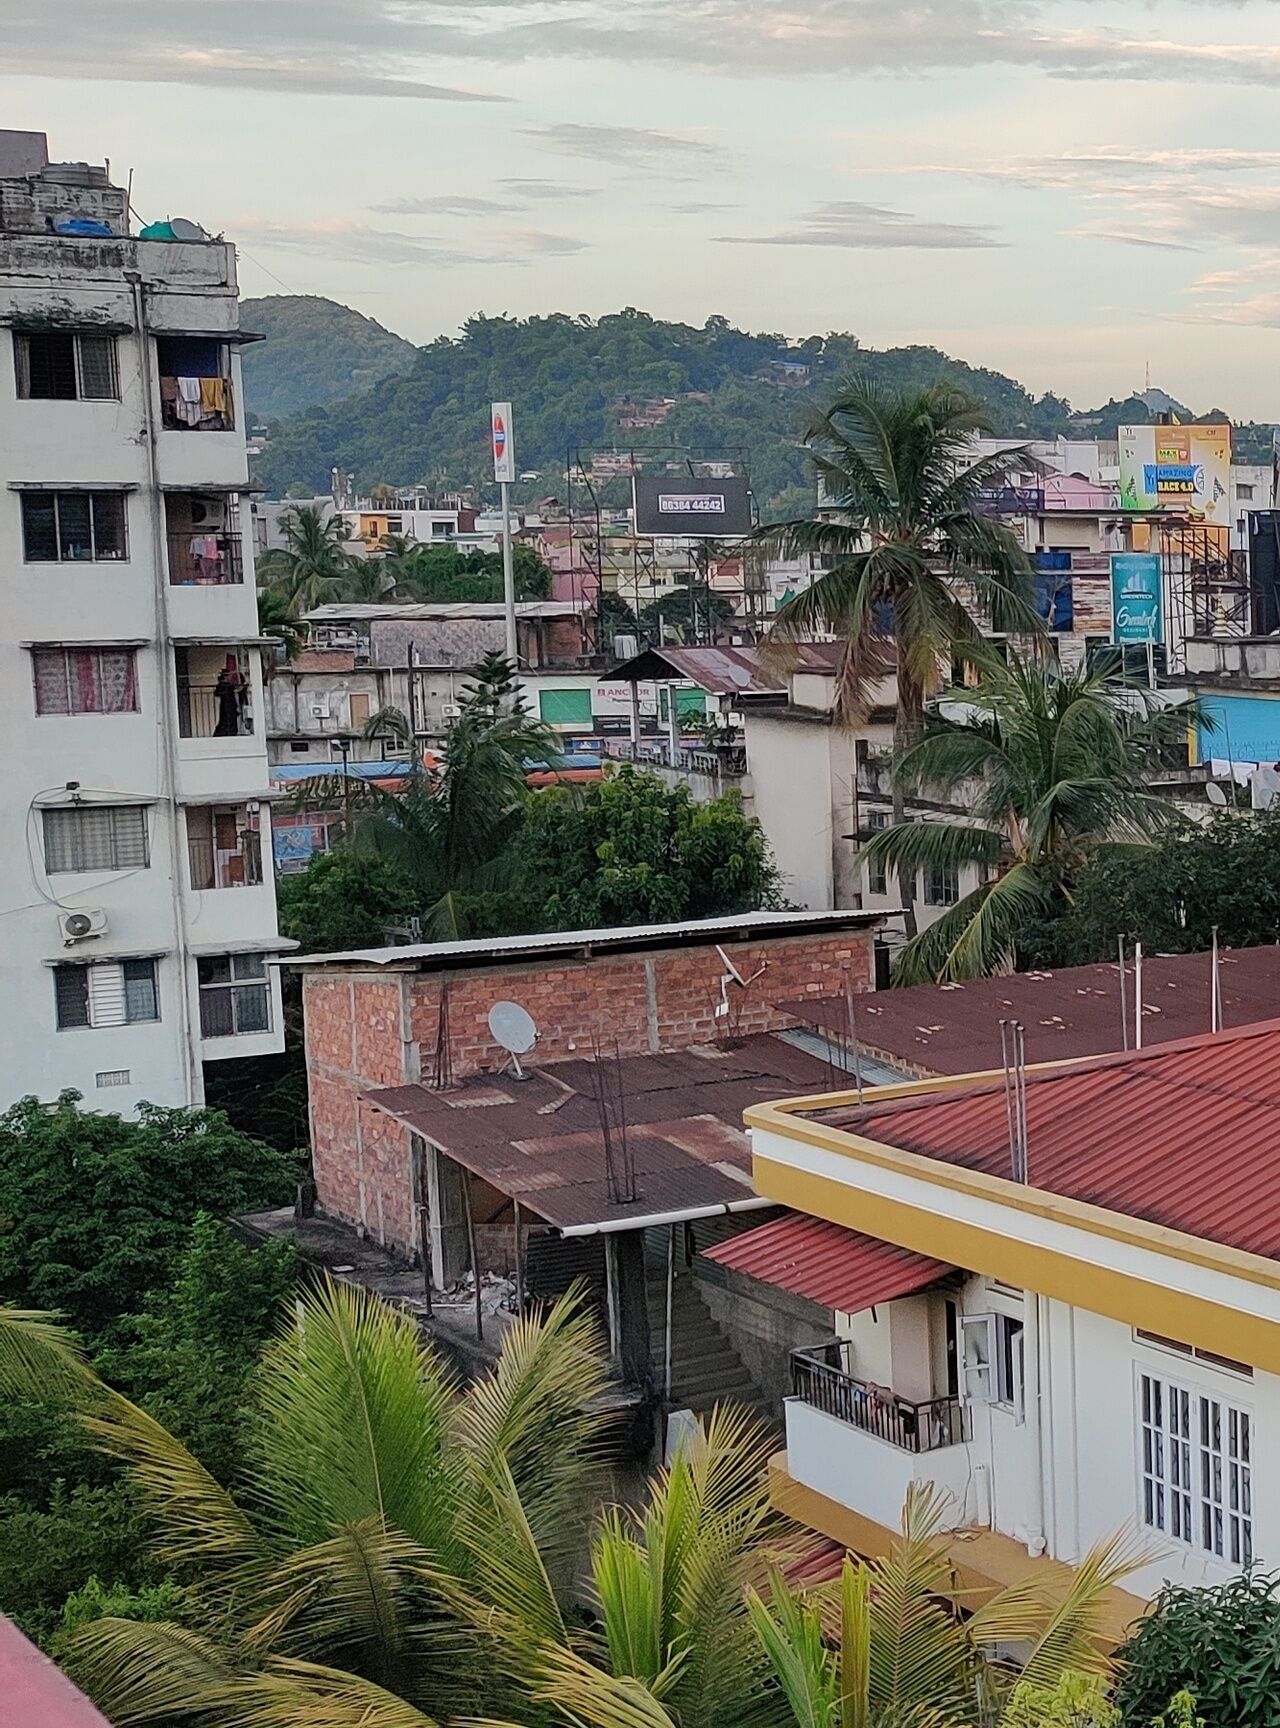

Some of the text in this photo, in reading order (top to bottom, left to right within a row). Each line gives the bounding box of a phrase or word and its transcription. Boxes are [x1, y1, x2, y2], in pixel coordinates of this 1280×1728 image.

[1159, 468, 1192, 478] AMAZING
[692, 501, 721, 510] 44242
[607, 688, 650, 696] ANCOR
